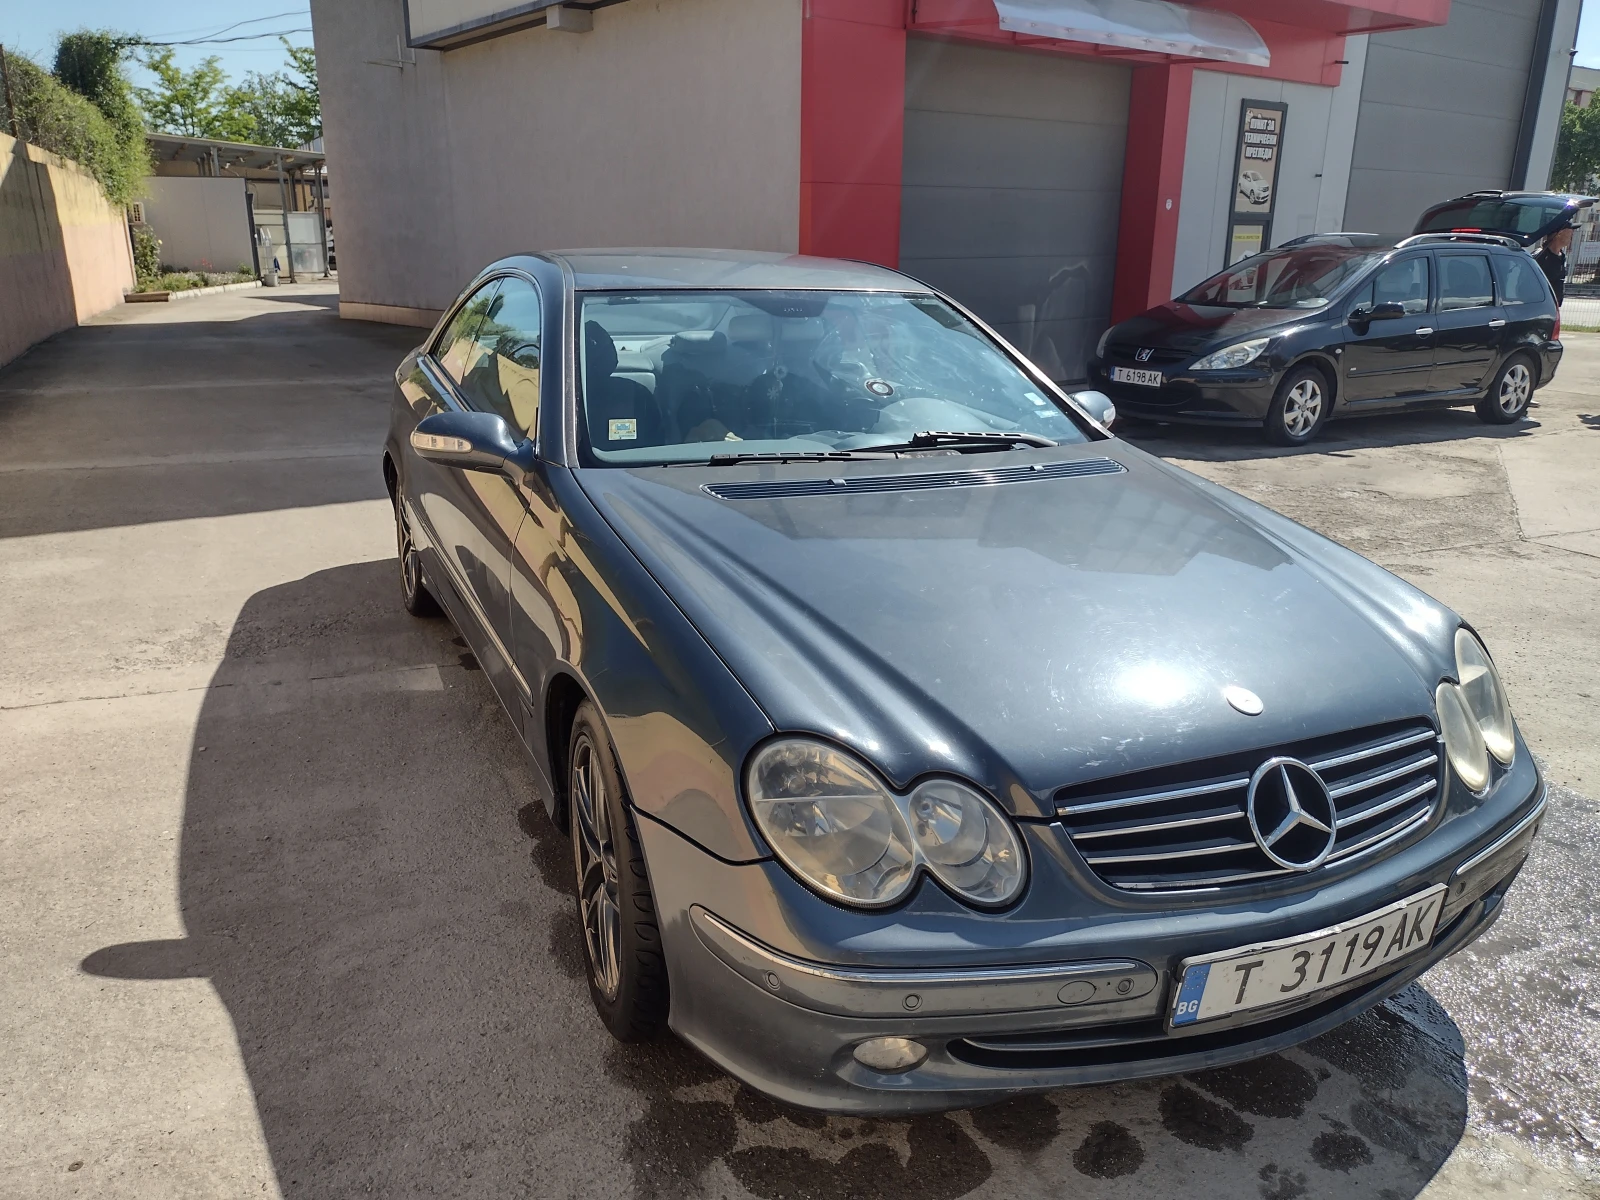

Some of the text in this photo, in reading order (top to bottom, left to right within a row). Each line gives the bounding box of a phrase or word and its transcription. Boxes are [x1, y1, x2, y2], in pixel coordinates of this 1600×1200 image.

[1118, 369, 1123, 380] T
[1234, 960, 1264, 1005] T
[1176, 999, 1199, 1015] BG
